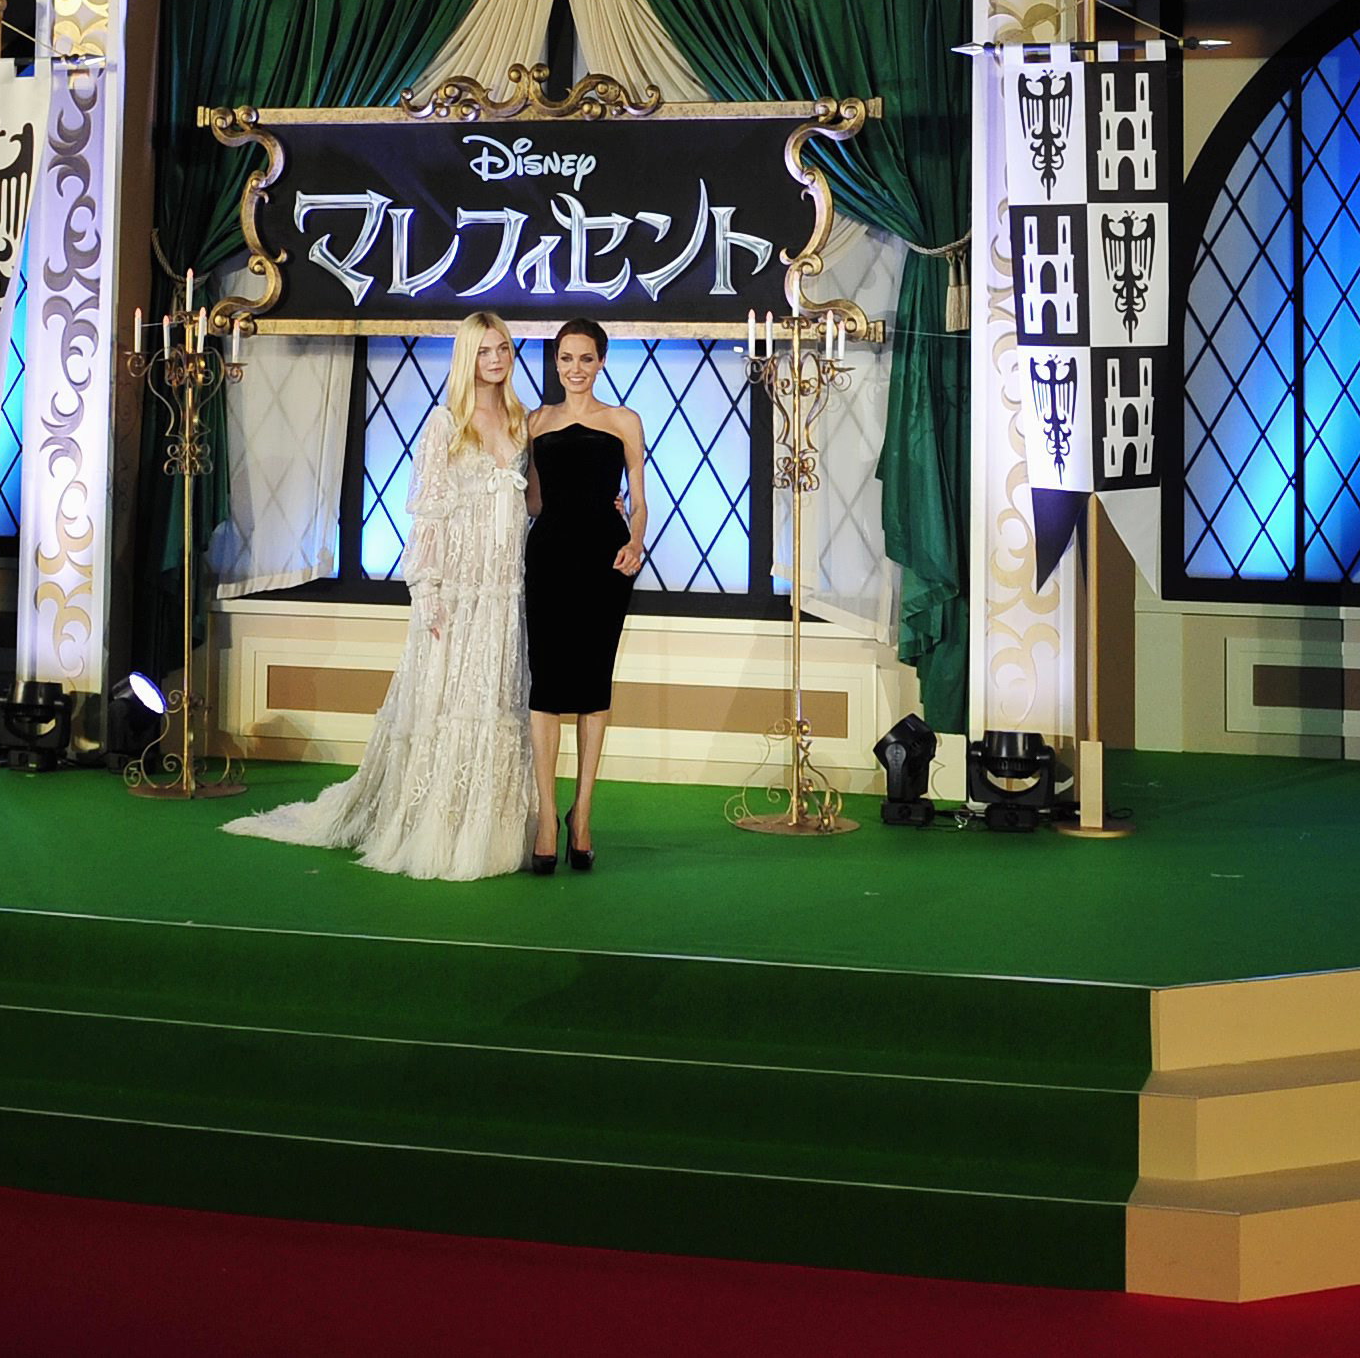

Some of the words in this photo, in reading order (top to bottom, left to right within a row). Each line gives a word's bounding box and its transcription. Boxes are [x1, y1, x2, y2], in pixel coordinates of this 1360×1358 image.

[294, 178, 774, 307] マレフィセント
